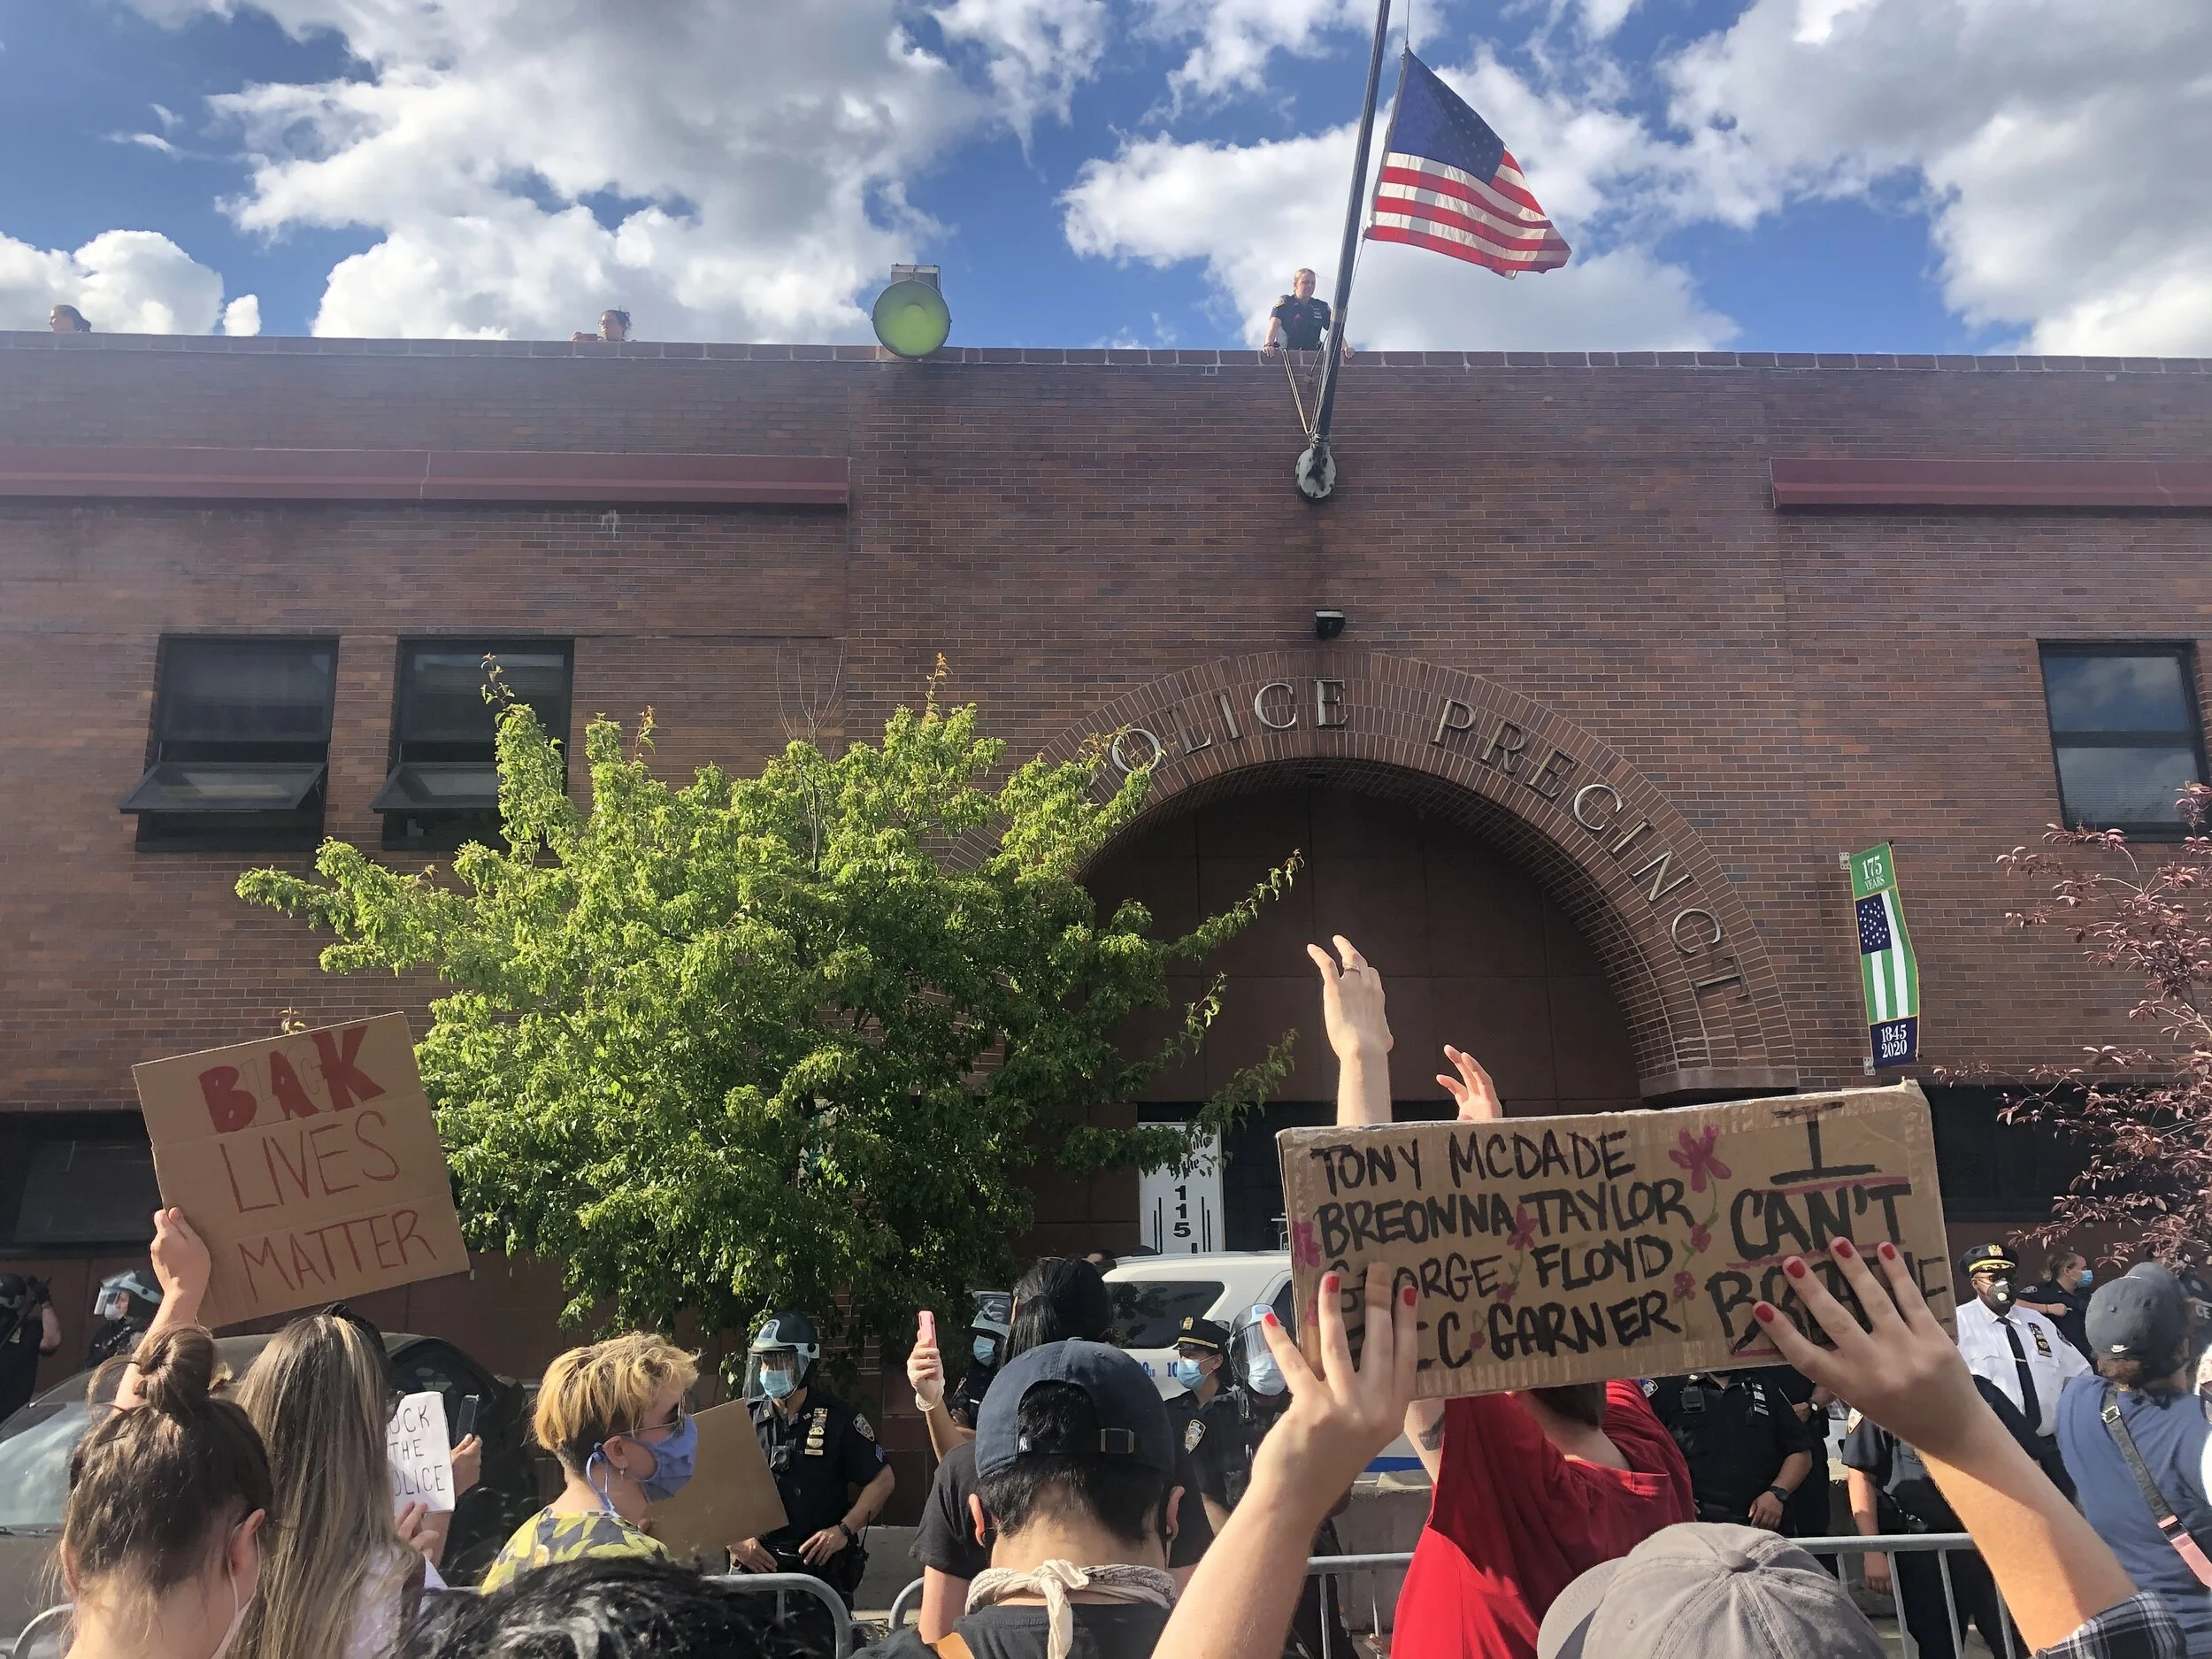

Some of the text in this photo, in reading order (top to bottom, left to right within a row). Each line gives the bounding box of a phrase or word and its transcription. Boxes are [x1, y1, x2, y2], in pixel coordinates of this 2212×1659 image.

[1077, 679, 1749, 1000] OLICE PRECINCT
[1862, 855, 1883, 880] 175
[1864, 876, 1886, 891] YEARS
[1880, 1024, 1907, 1043] 1845
[1881, 1040, 1908, 1058] 2020
[219, 1110, 400, 1213] LIVES
[1310, 1128, 1635, 1196] TONY MCDADE
[1770, 1101, 1882, 1186] I
[1313, 1177, 1695, 1258] BREONNA TAYLOR
[1731, 1183, 1912, 1262] CAN'T
[238, 1210, 437, 1303] MATTER
[1530, 1234, 1674, 1291] FLOYD
[1488, 1289, 1683, 1362] GARNER
[389, 1404, 430, 1433] UCK
[389, 1438, 425, 1461] THE
